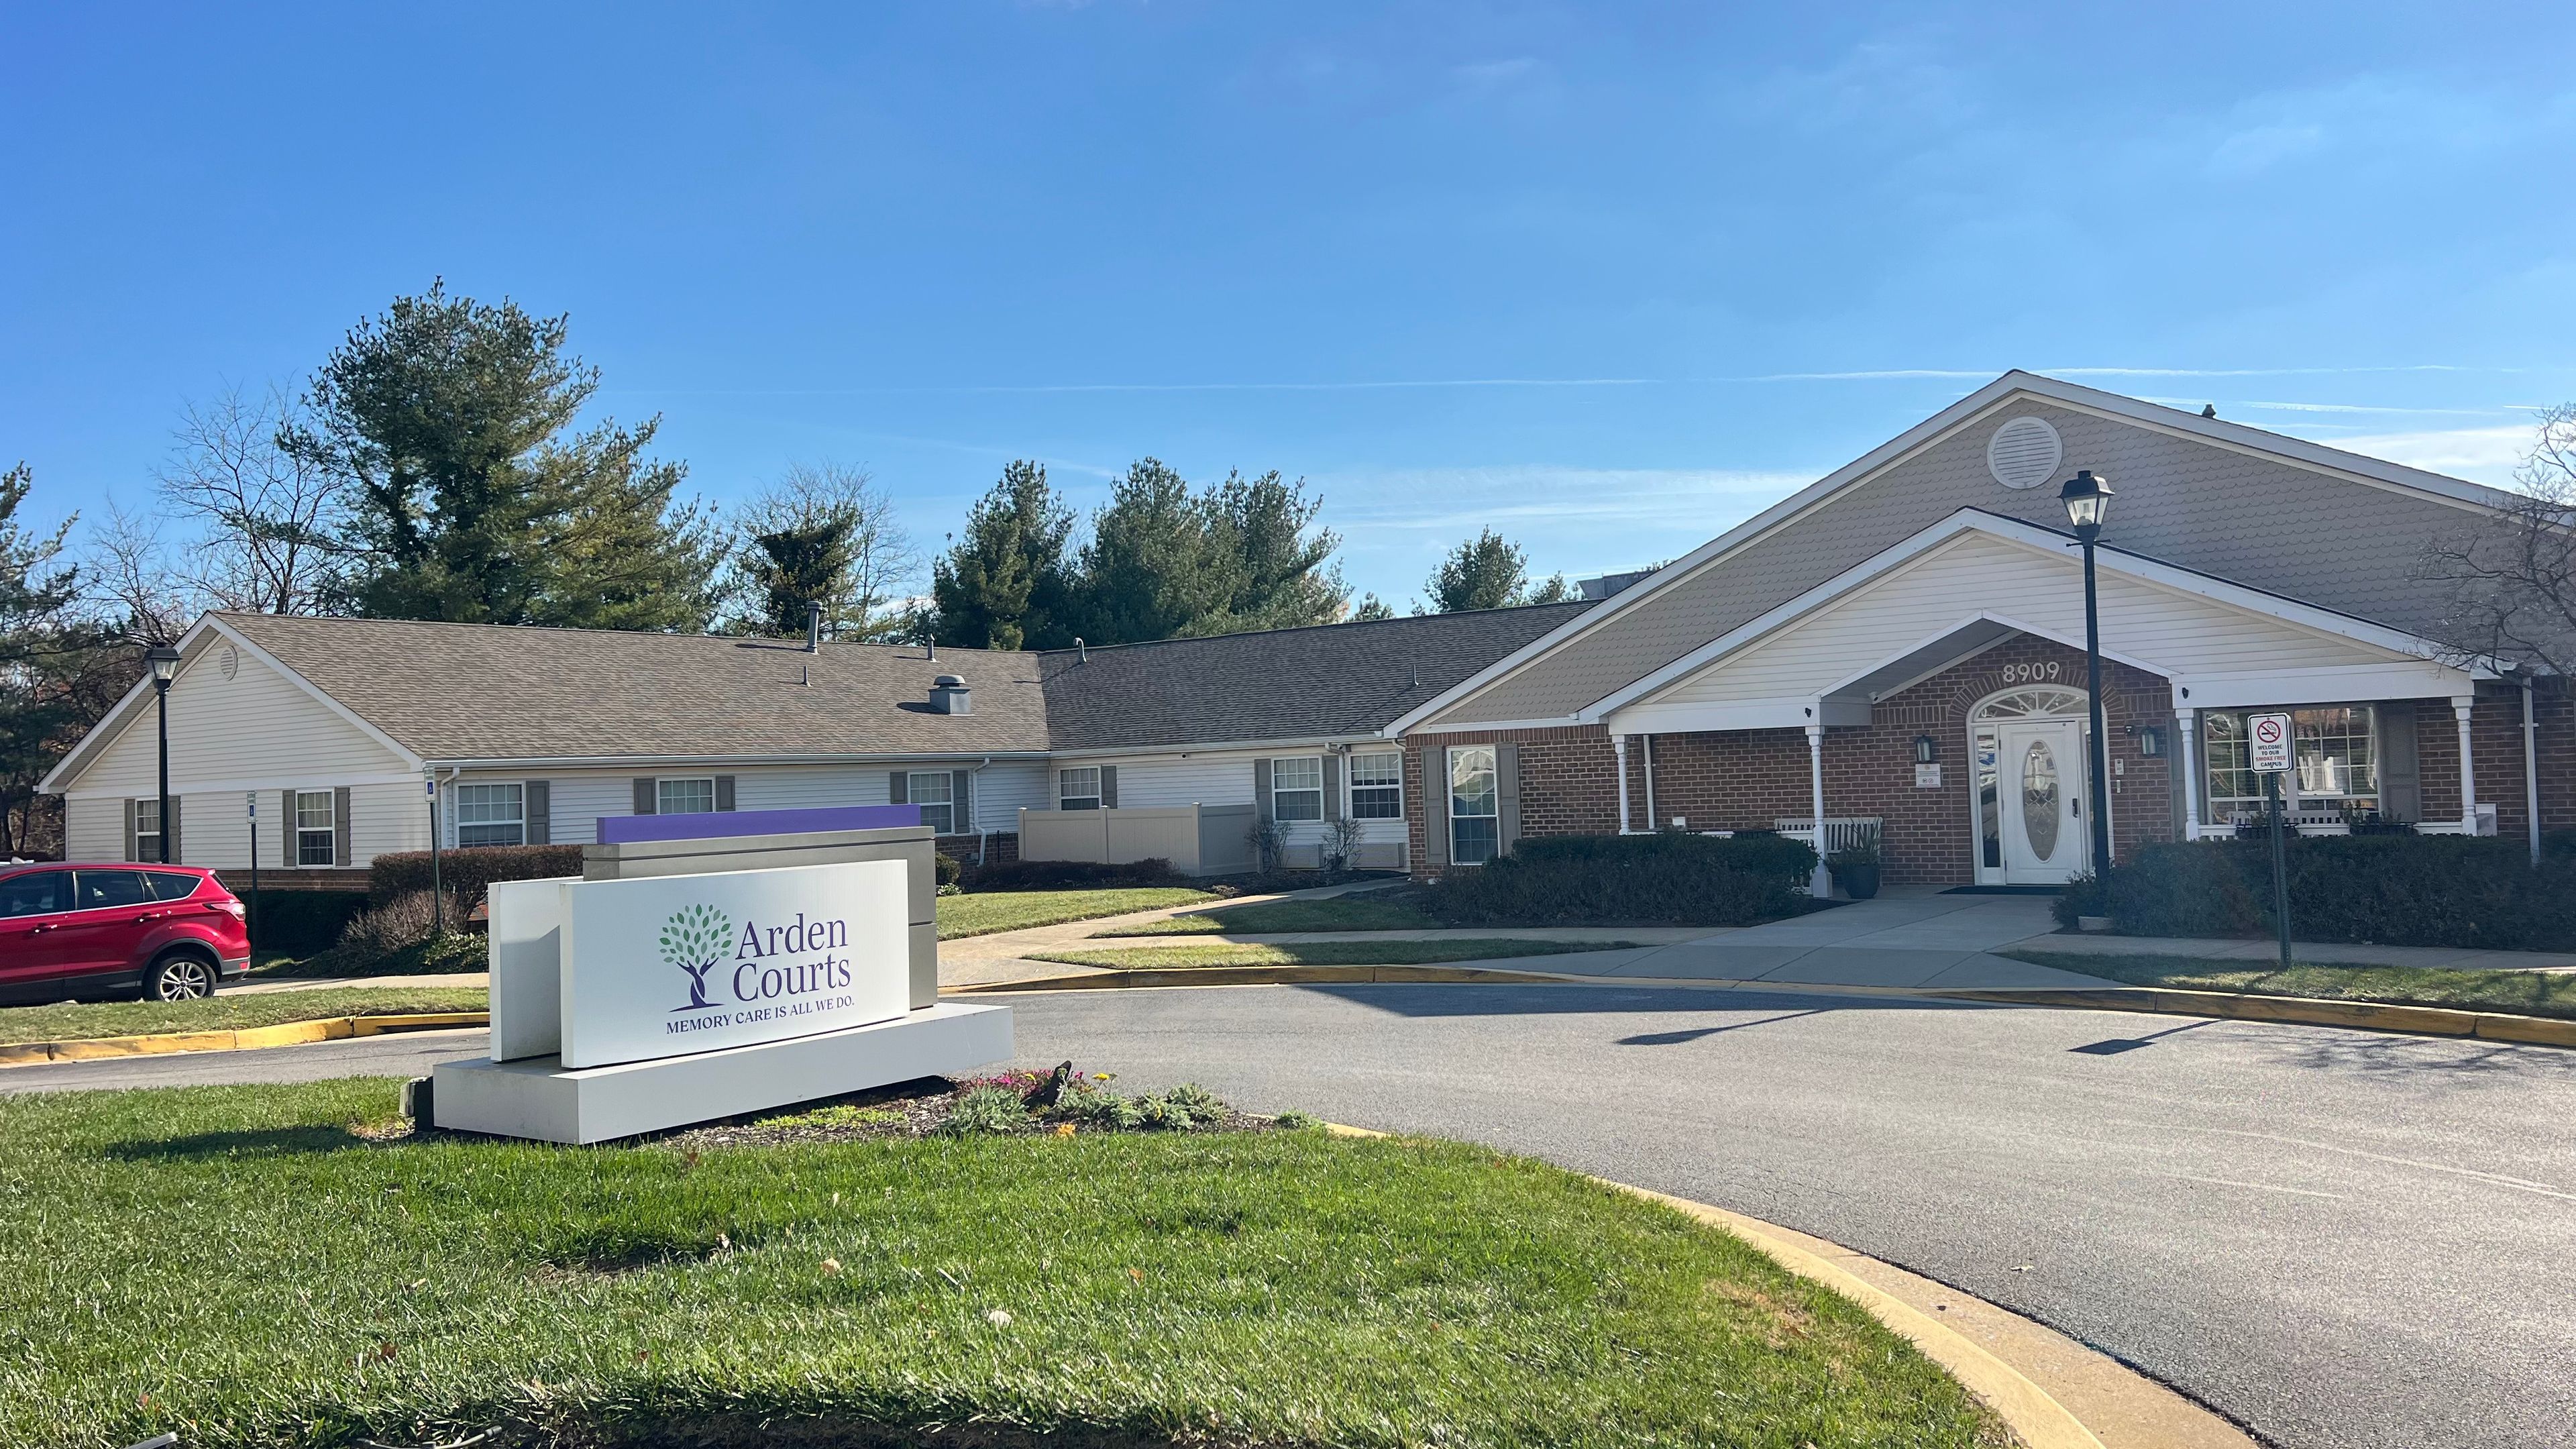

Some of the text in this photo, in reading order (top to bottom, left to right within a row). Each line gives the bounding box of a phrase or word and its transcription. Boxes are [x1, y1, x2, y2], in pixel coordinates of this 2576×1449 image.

[2004, 661, 2059, 682] 8909
[735, 913, 848, 960] Arden
[733, 953, 851, 1002] Courts
[666, 996, 855, 1034] MEMORY CARE IS ALL WE DO.
